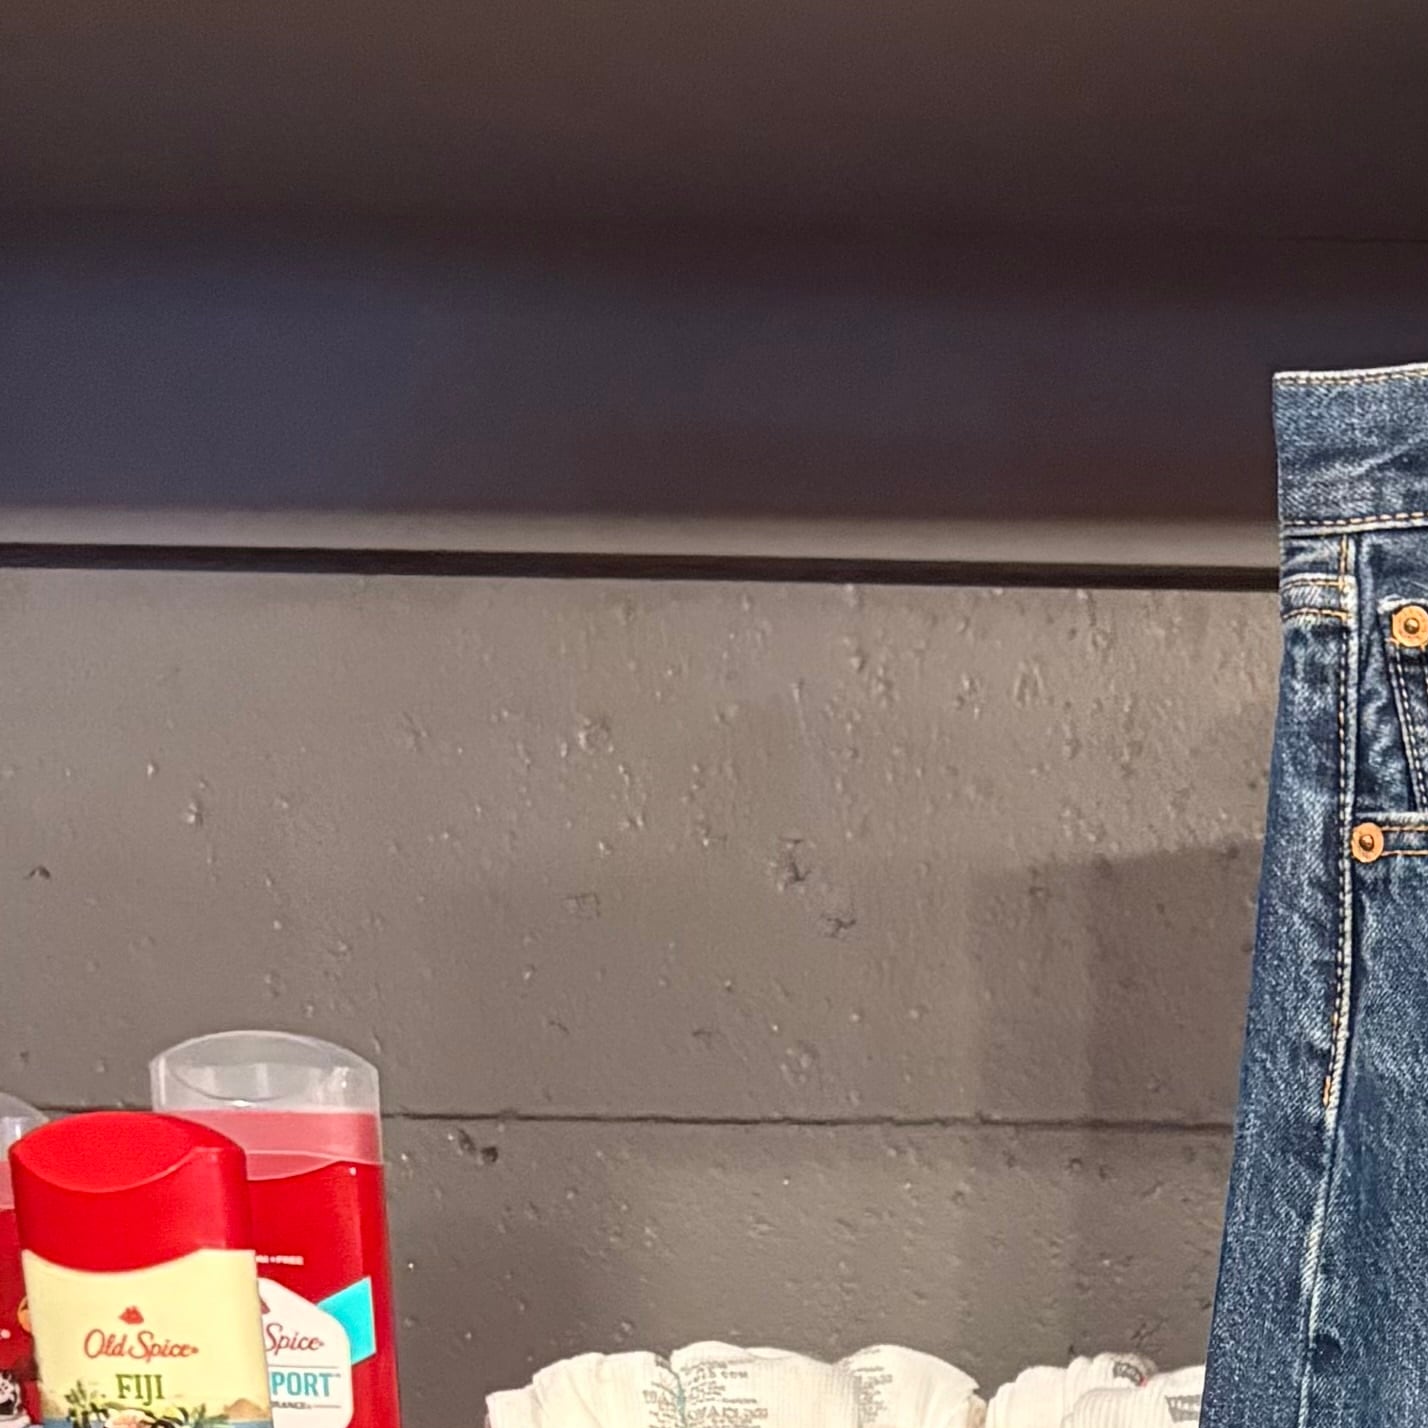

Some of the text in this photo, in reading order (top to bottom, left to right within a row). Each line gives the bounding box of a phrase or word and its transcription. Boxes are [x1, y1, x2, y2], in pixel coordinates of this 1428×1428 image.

[84, 1328, 193, 1363] Old Spice
[265, 1322, 320, 1356] Spice
[115, 1374, 165, 1406] FIJI
[270, 1371, 332, 1397] PORT
